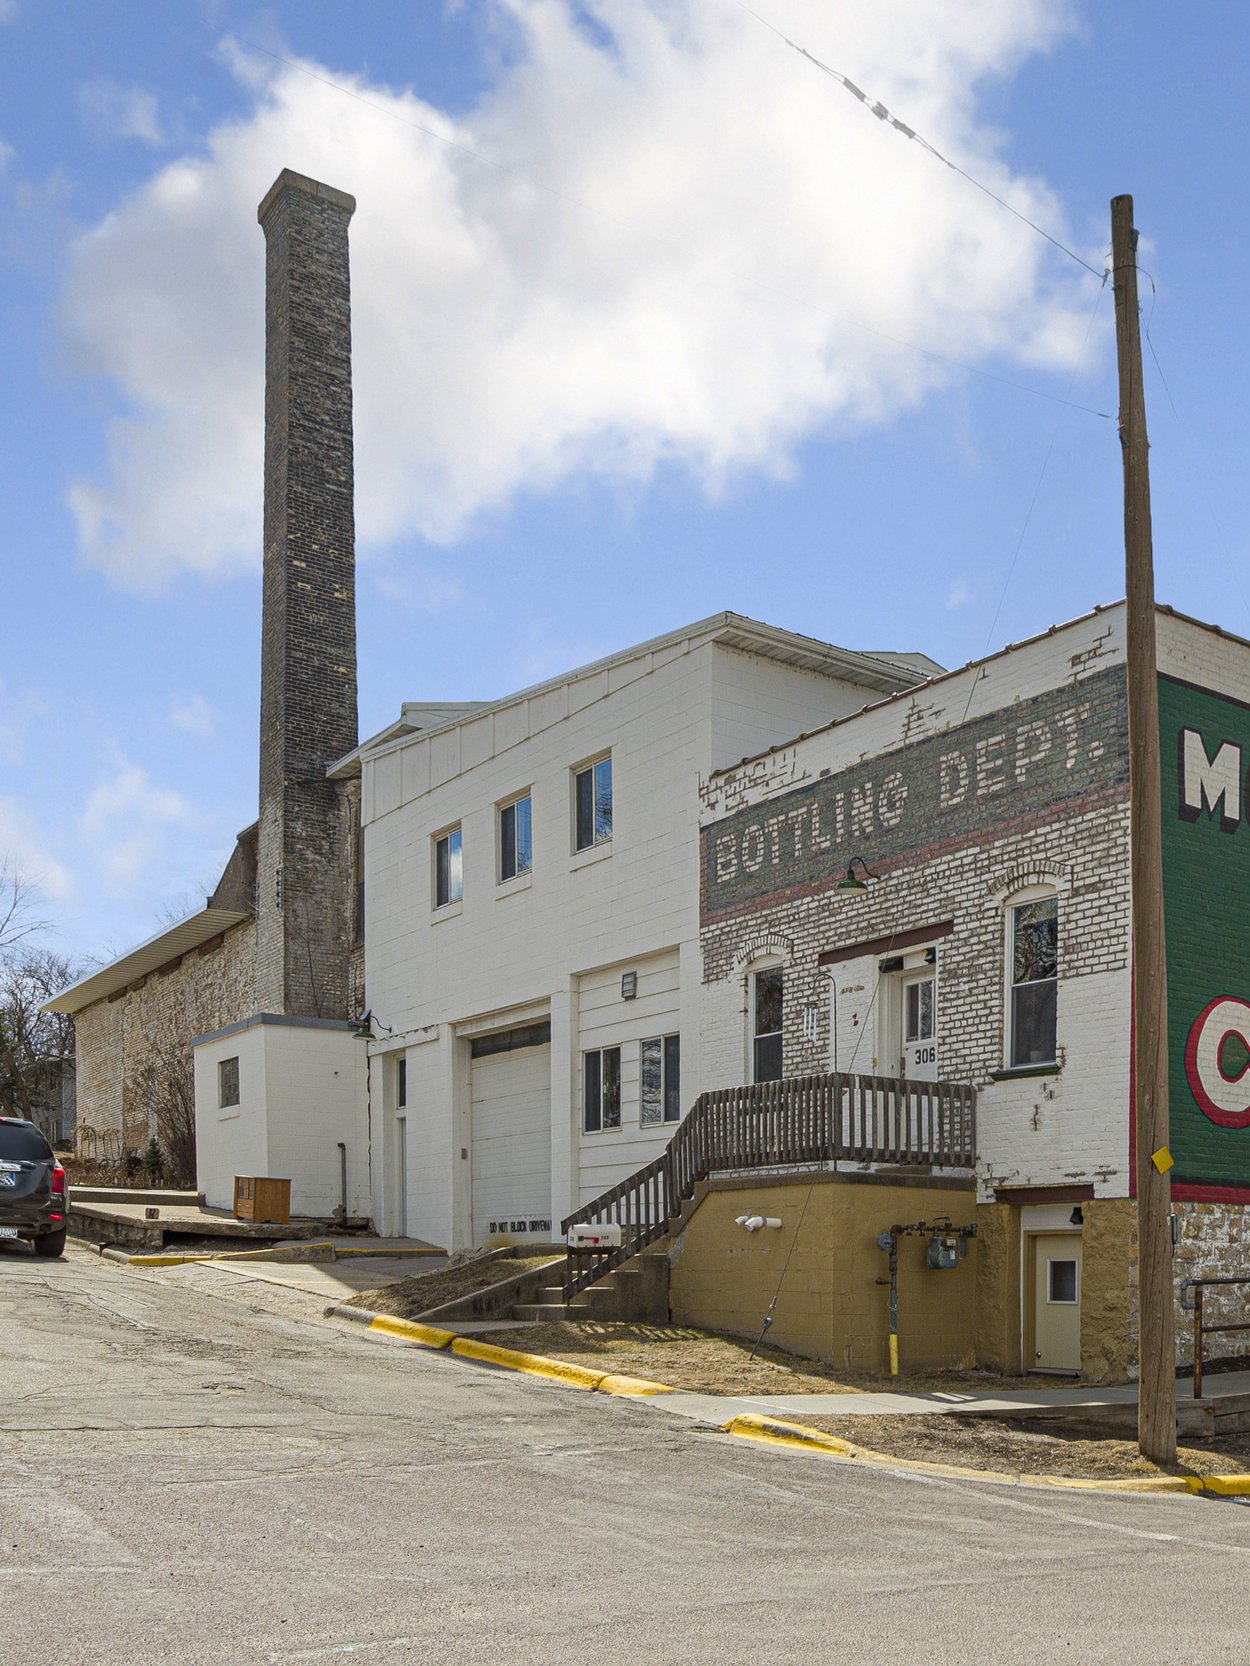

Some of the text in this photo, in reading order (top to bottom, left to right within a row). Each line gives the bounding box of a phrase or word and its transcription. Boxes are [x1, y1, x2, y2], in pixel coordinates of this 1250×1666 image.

[716, 772, 908, 883] BOTTLING
[915, 1047, 936, 1065] 306
[490, 1222, 498, 1234] DO
[499, 1221, 509, 1233] NOT
[511, 1220, 528, 1233] BLOCK
